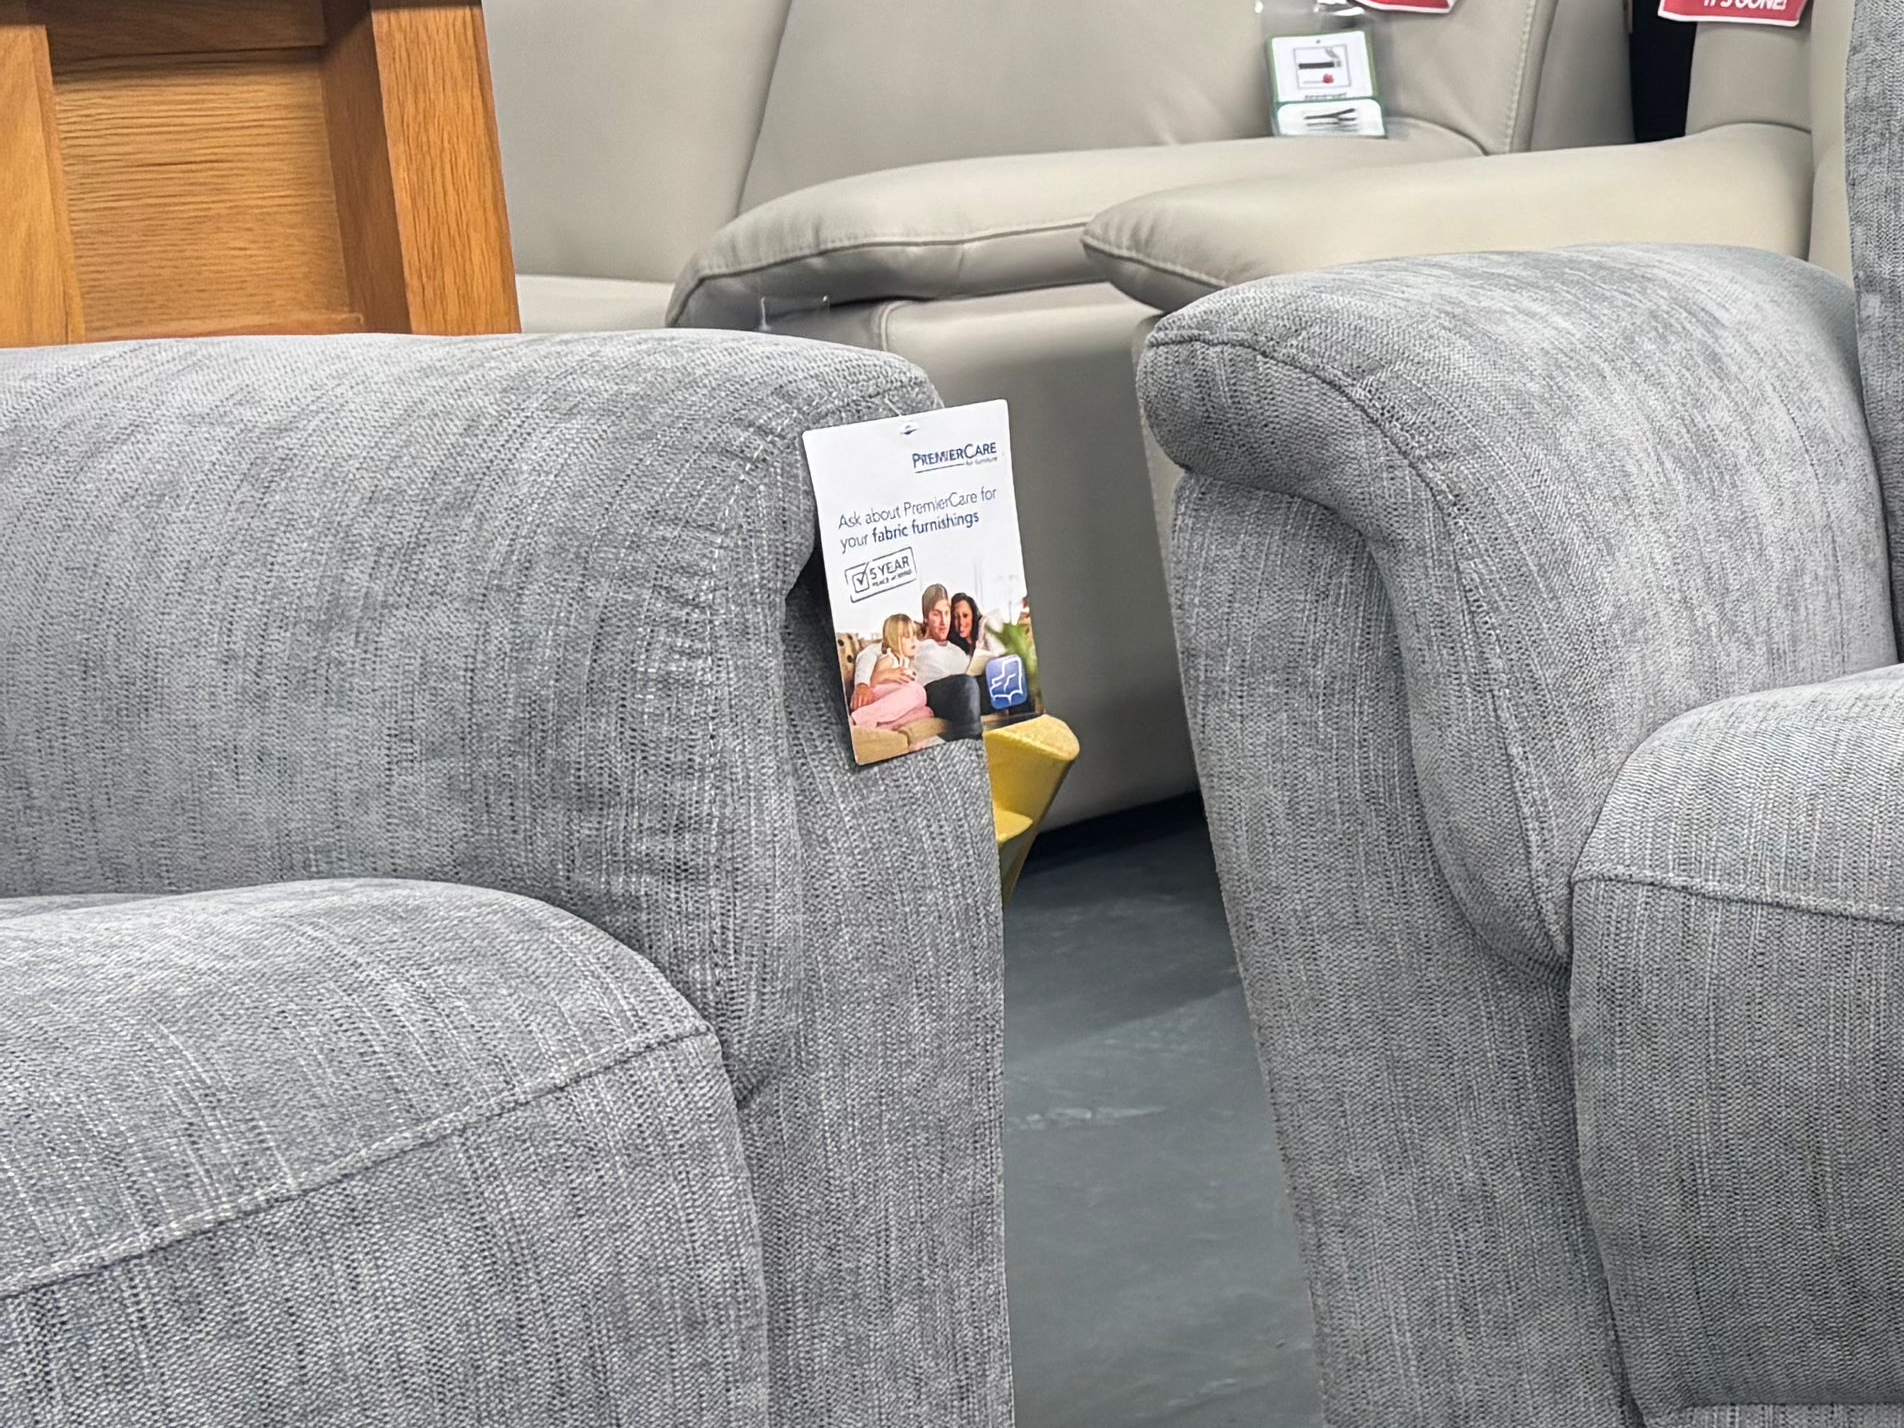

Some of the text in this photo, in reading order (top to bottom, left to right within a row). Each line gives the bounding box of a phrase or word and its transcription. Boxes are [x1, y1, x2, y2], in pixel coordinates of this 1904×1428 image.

[838, 485, 997, 530] Ask about PremierCare for
[840, 511, 980, 554] your fabric furnishings
[869, 567, 877, 580] 5
[877, 555, 910, 576] YEAR
